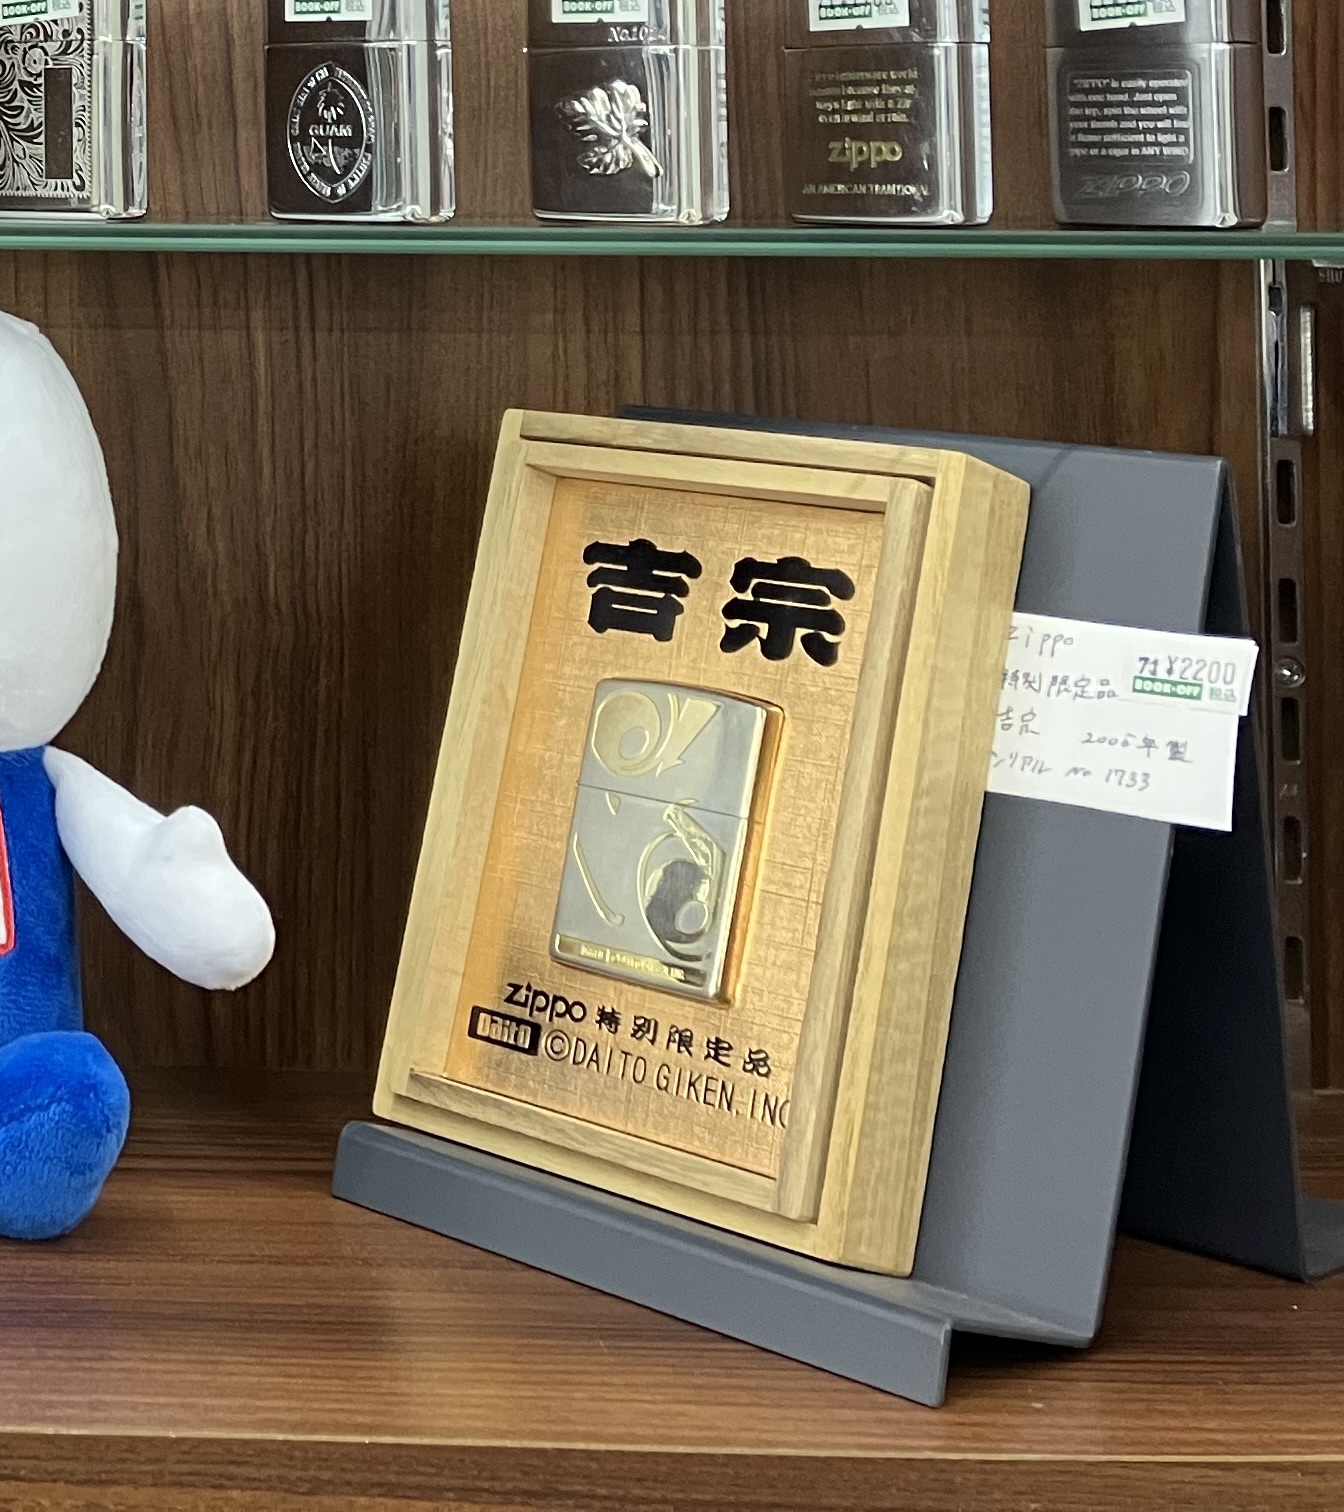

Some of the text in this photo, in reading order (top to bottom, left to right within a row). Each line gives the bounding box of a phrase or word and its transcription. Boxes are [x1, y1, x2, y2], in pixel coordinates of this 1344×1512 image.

[583, 538, 855, 667] 吉宗
[1138, 655, 1236, 685] 71 ¥2200
[1105, 769, 1151, 792] 1733
[595, 1005, 773, 1078] 特別限定品
